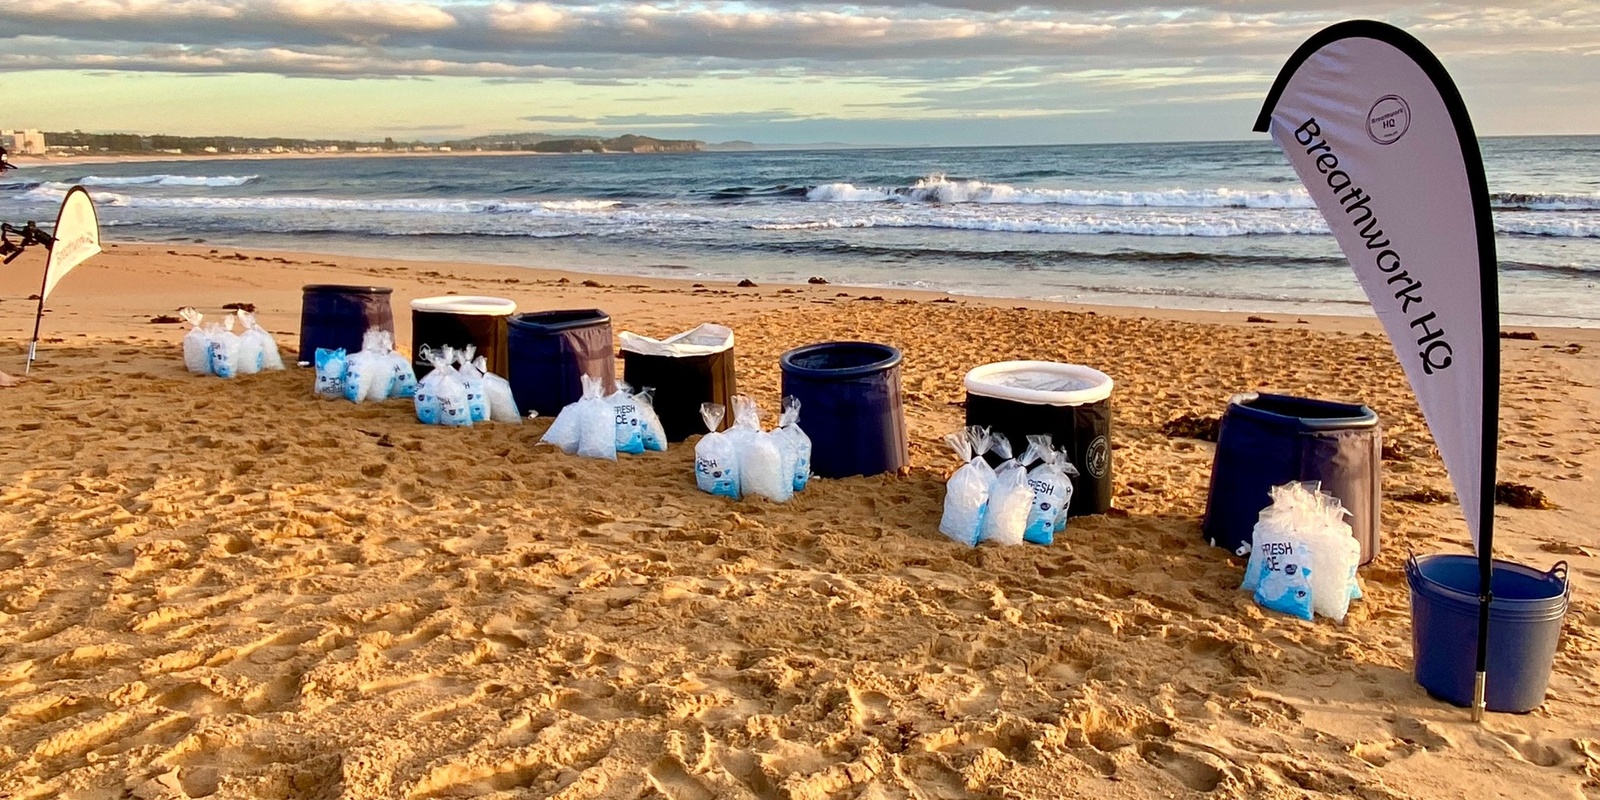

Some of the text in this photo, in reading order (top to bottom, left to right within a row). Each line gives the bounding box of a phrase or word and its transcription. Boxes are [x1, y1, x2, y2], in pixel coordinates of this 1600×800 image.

[1383, 118, 1396, 129] HQ
[1294, 117, 1453, 375] Breathwork HQ
[615, 414, 628, 425] CE
[1261, 542, 1293, 556] FRESH
[1265, 556, 1281, 572] CE
